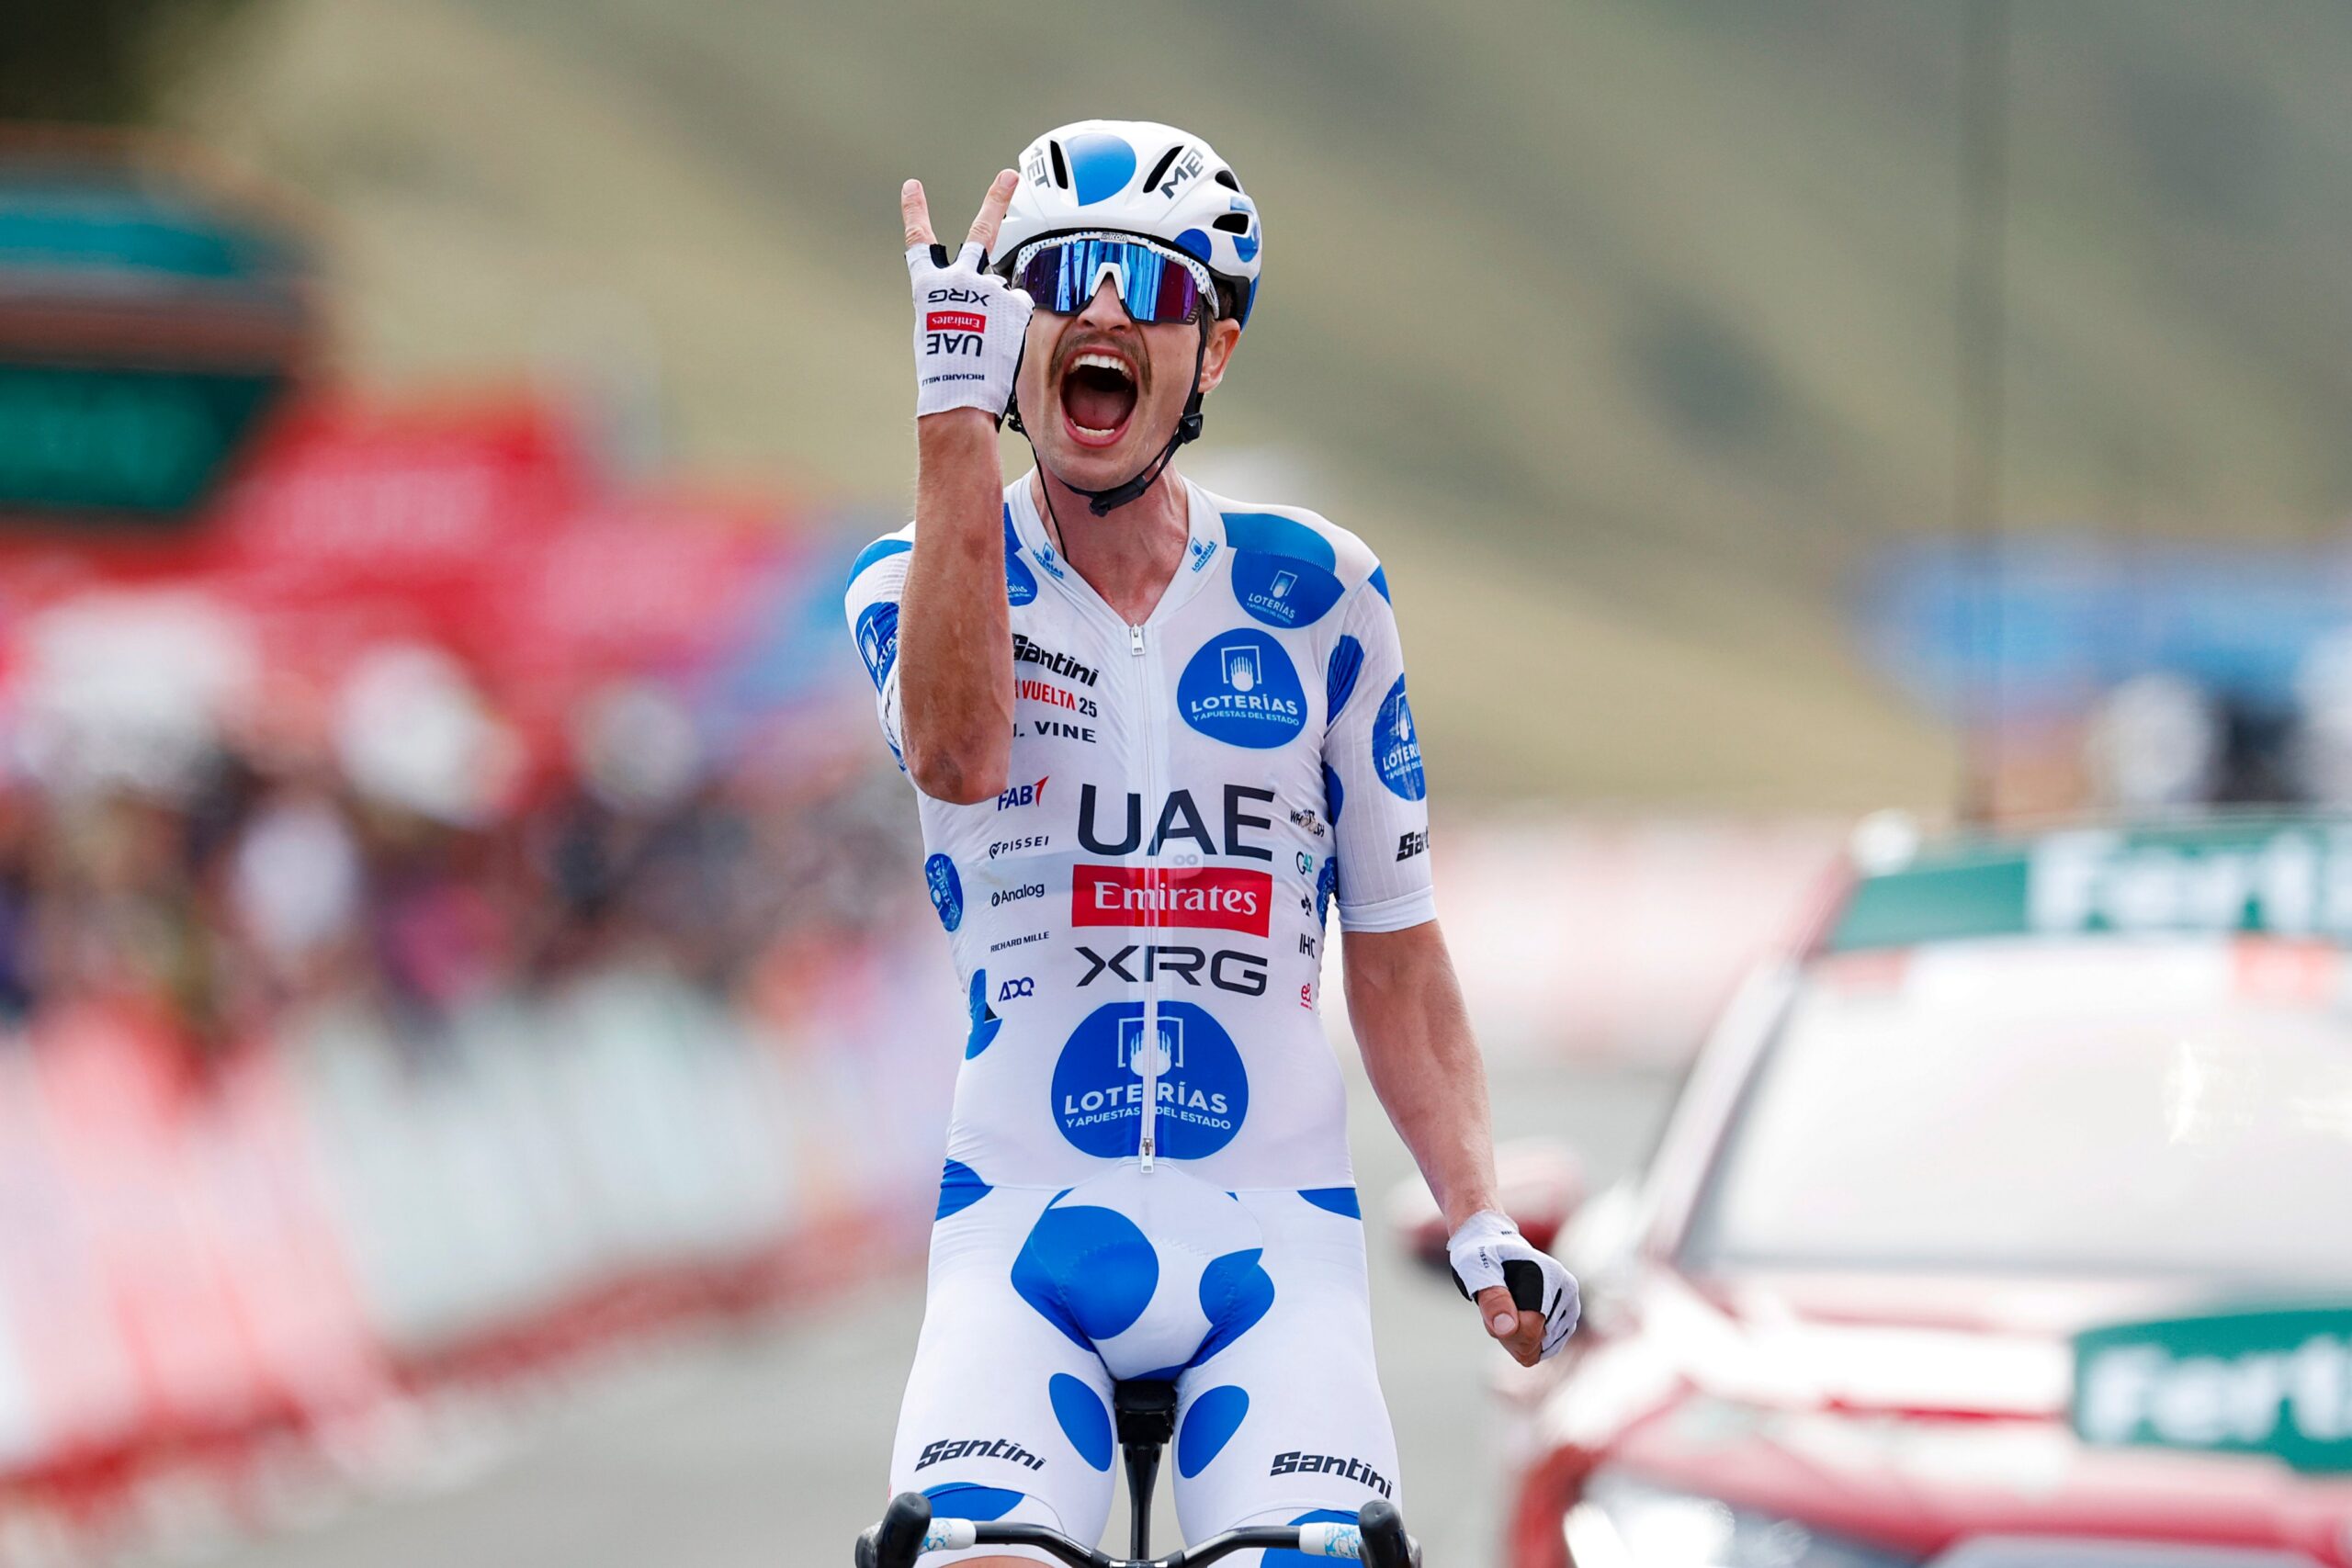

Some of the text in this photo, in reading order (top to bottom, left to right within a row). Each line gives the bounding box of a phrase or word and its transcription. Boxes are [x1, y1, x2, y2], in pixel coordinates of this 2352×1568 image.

[928, 288, 990, 307] XRG
[932, 316, 981, 329] Emirates
[927, 333, 983, 357] UAE
[943, 373, 985, 381] RICHARD
[1248, 592, 1295, 620] LOTERÍAS
[1012, 633, 1100, 688] Santini
[1079, 696, 1098, 718] 25
[1191, 694, 1298, 716] LOTERÍAS
[1200, 711, 1247, 720] APUESTAS
[1248, 711, 1265, 720] DEL
[1266, 714, 1299, 727] ESTADO
[1035, 721, 1097, 743] VINE
[1076, 783, 1275, 863] UAE
[1001, 836, 1049, 854] PISSEI
[1001, 883, 1045, 905] Analog
[1094, 881, 1258, 916] Emirates
[990, 931, 1049, 953] RICHARD MILLE
[1073, 945, 1269, 997] XRG
[998, 976, 1035, 1003] ADQ
[1064, 1081, 1228, 1115] LOTERÍAS
[1066, 1106, 1231, 1130] Y APUESTAS DEL ESTADO
[914, 1438, 1046, 1472] Santini
[1270, 1451, 1393, 1500] Santini
